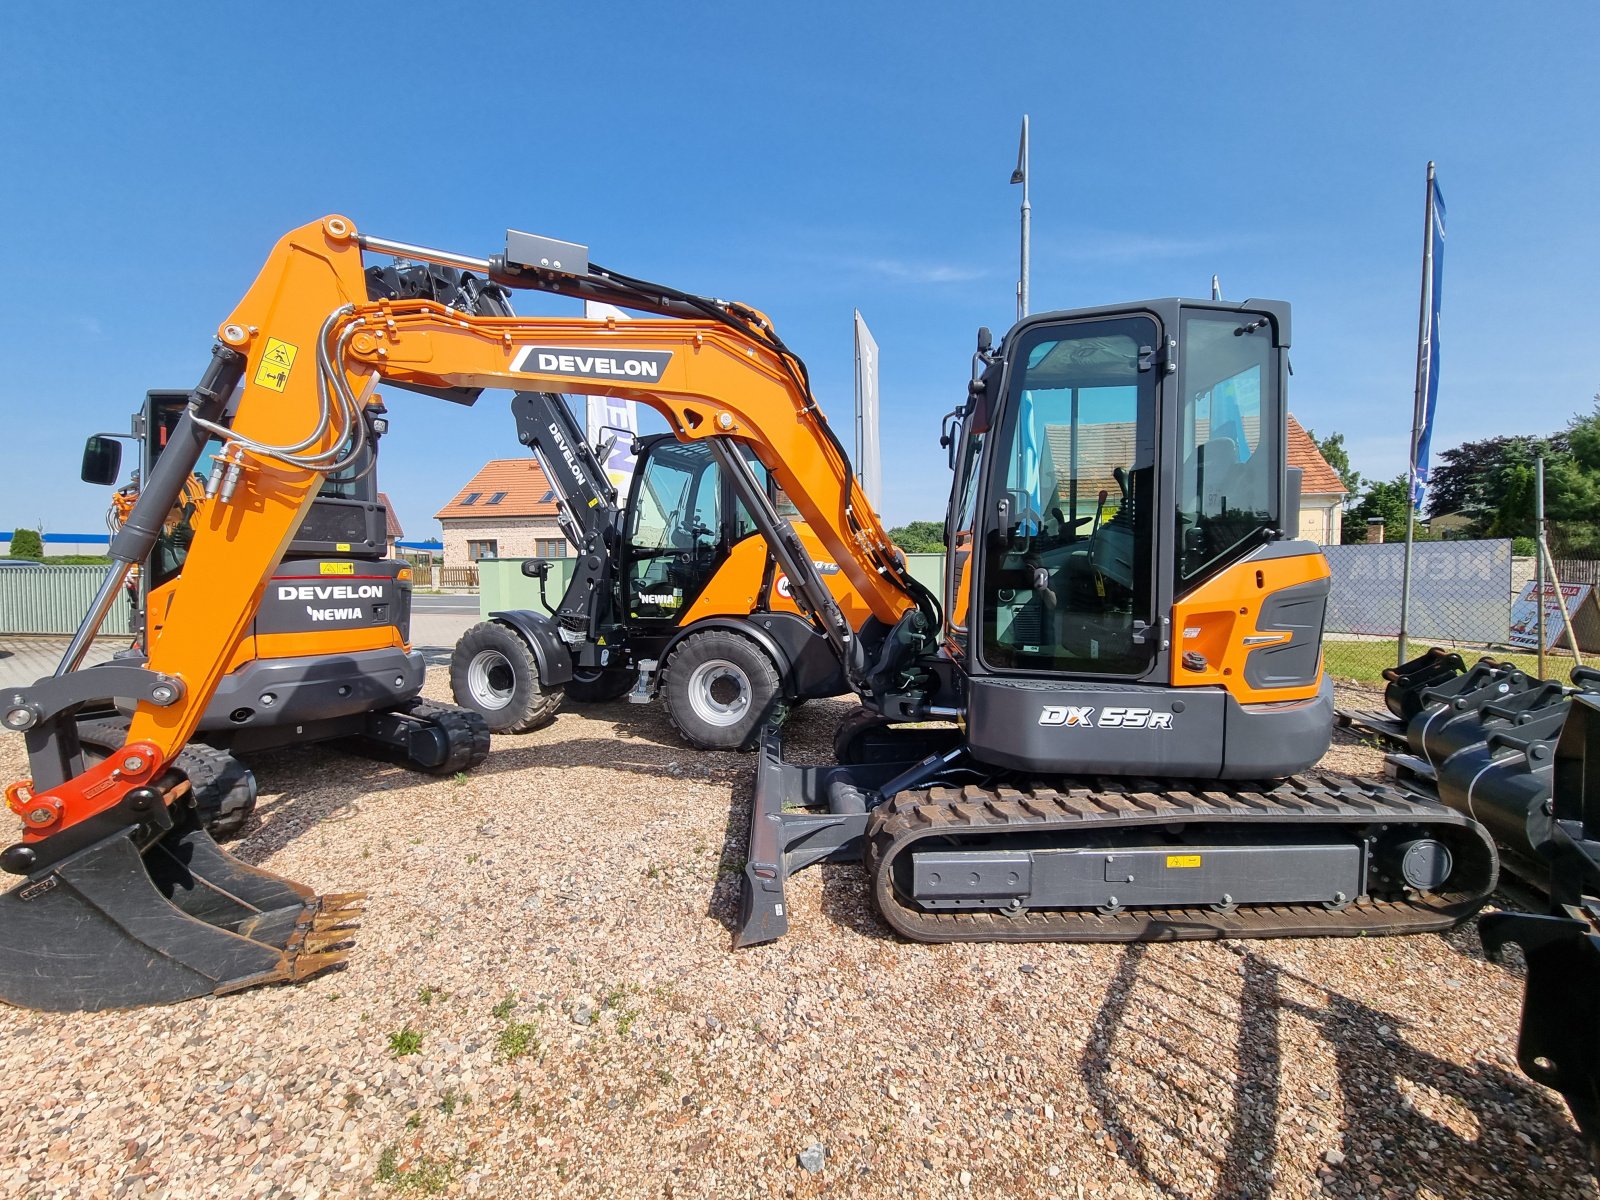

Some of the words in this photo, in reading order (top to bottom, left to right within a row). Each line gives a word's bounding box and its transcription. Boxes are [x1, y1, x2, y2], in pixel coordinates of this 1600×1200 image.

[538, 353, 658, 377] DEVELON
[548, 422, 586, 486] DEVELON
[278, 585, 383, 601] DEVELON
[641, 594, 674, 604] NEWIA
[311, 606, 363, 621] NEWIA
[1039, 705, 1094, 727] DX
[1098, 706, 1173, 730] 55R
